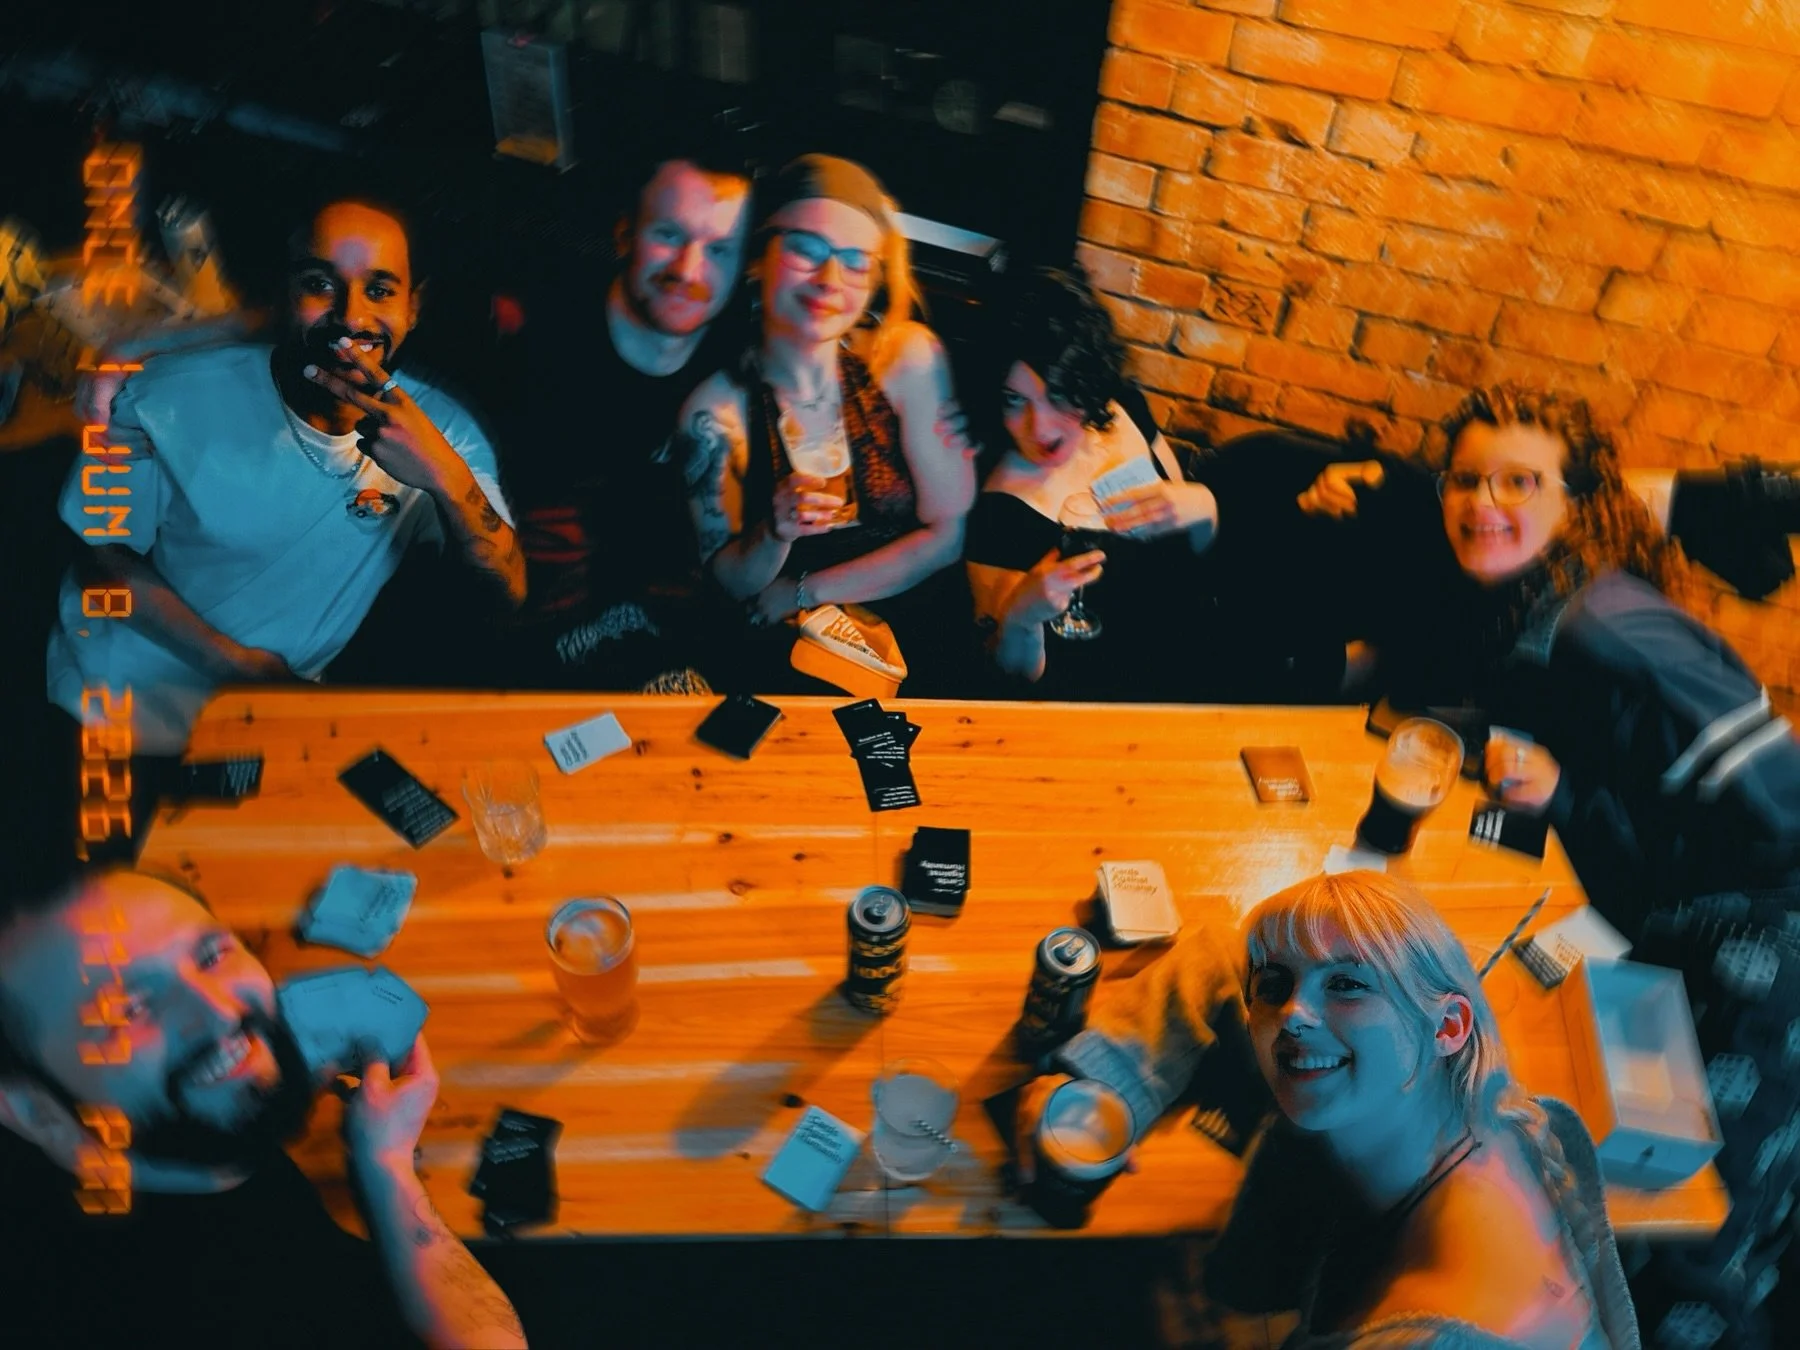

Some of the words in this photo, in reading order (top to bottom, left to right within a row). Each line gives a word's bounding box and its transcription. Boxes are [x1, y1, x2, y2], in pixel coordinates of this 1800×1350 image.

[919, 859, 966, 871] Humanity
[926, 869, 966, 879] Against
[934, 877, 966, 887] Cards
